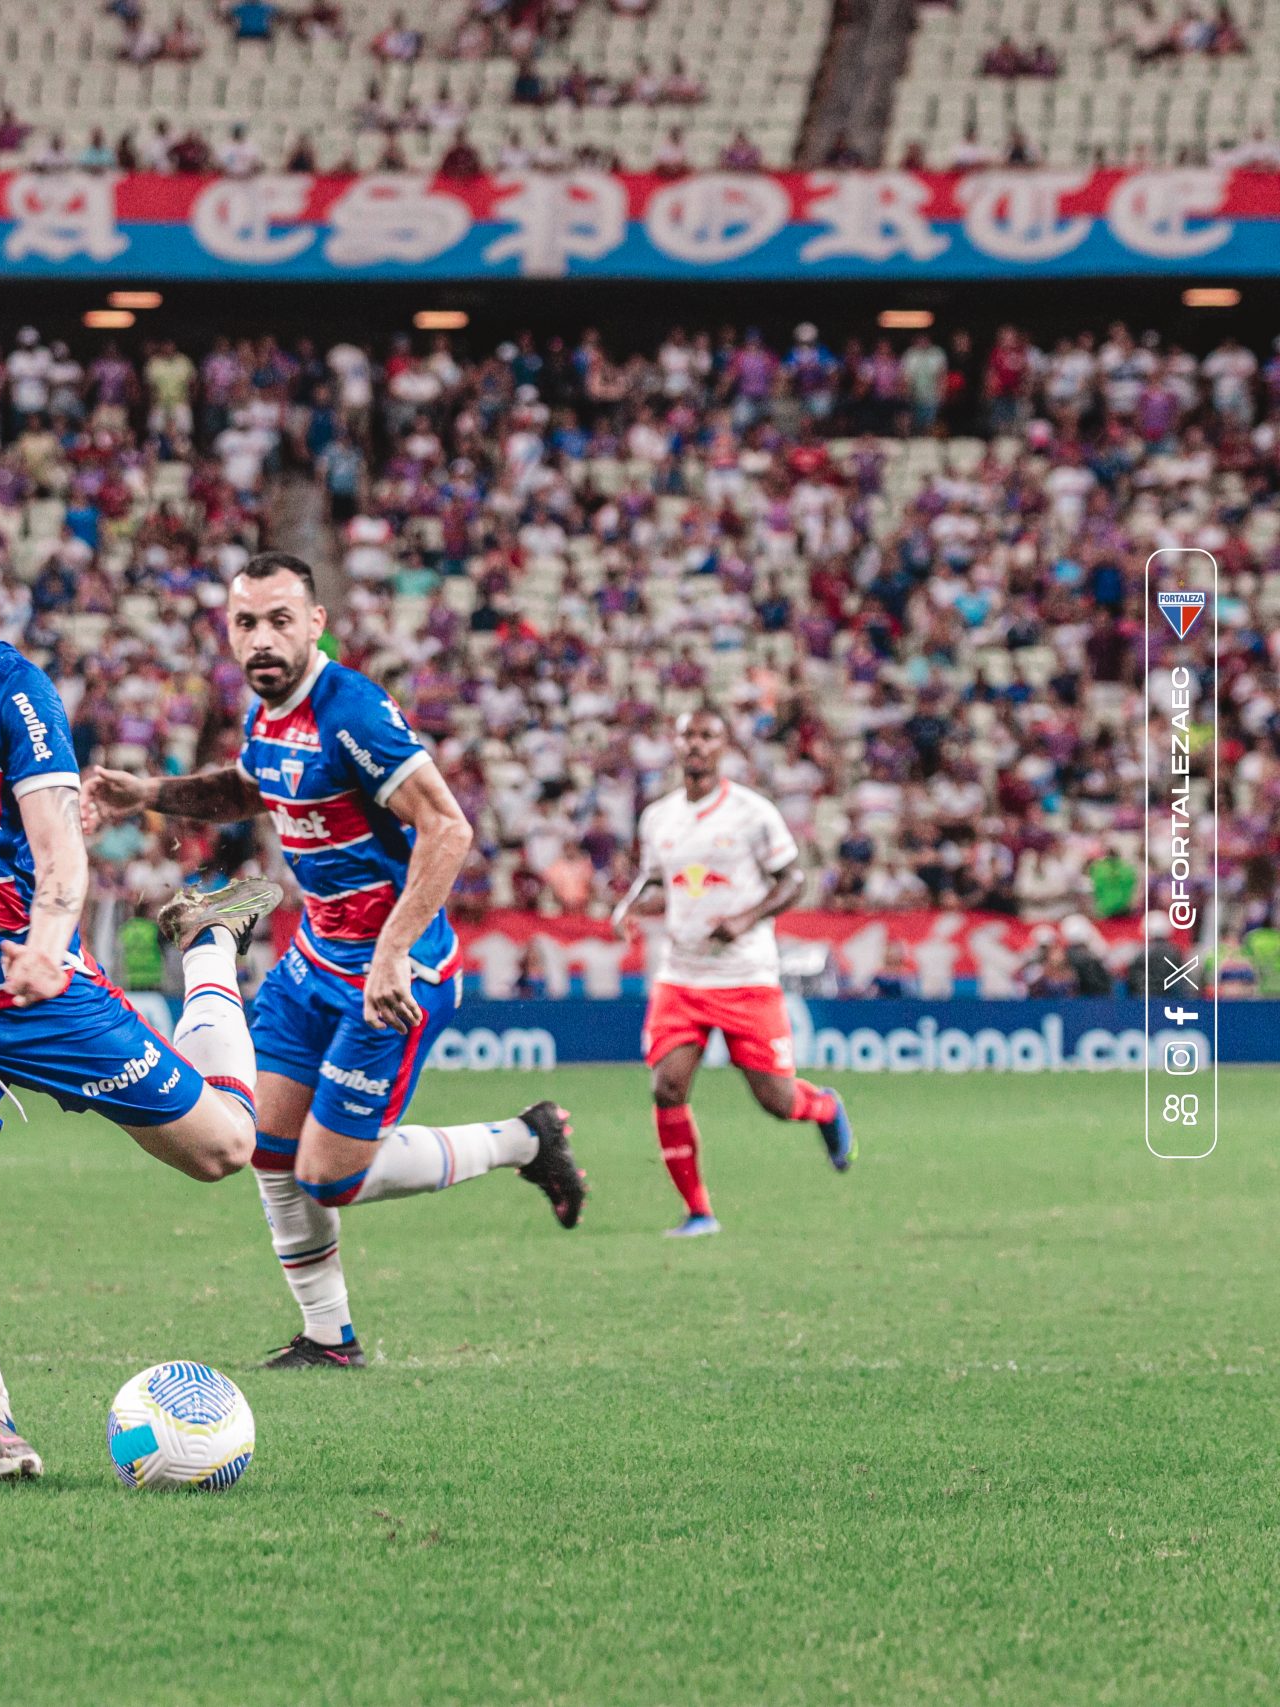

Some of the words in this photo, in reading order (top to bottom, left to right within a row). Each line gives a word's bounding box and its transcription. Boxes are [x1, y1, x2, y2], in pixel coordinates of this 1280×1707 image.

[190, 168, 1236, 277] ESPORTE
[11, 691, 53, 763] novibet
[335, 729, 386, 779] novibet
[81, 1039, 162, 1097] novibet
[814, 1012, 1211, 1073] nacional.com
[319, 1060, 391, 1096] novibet
